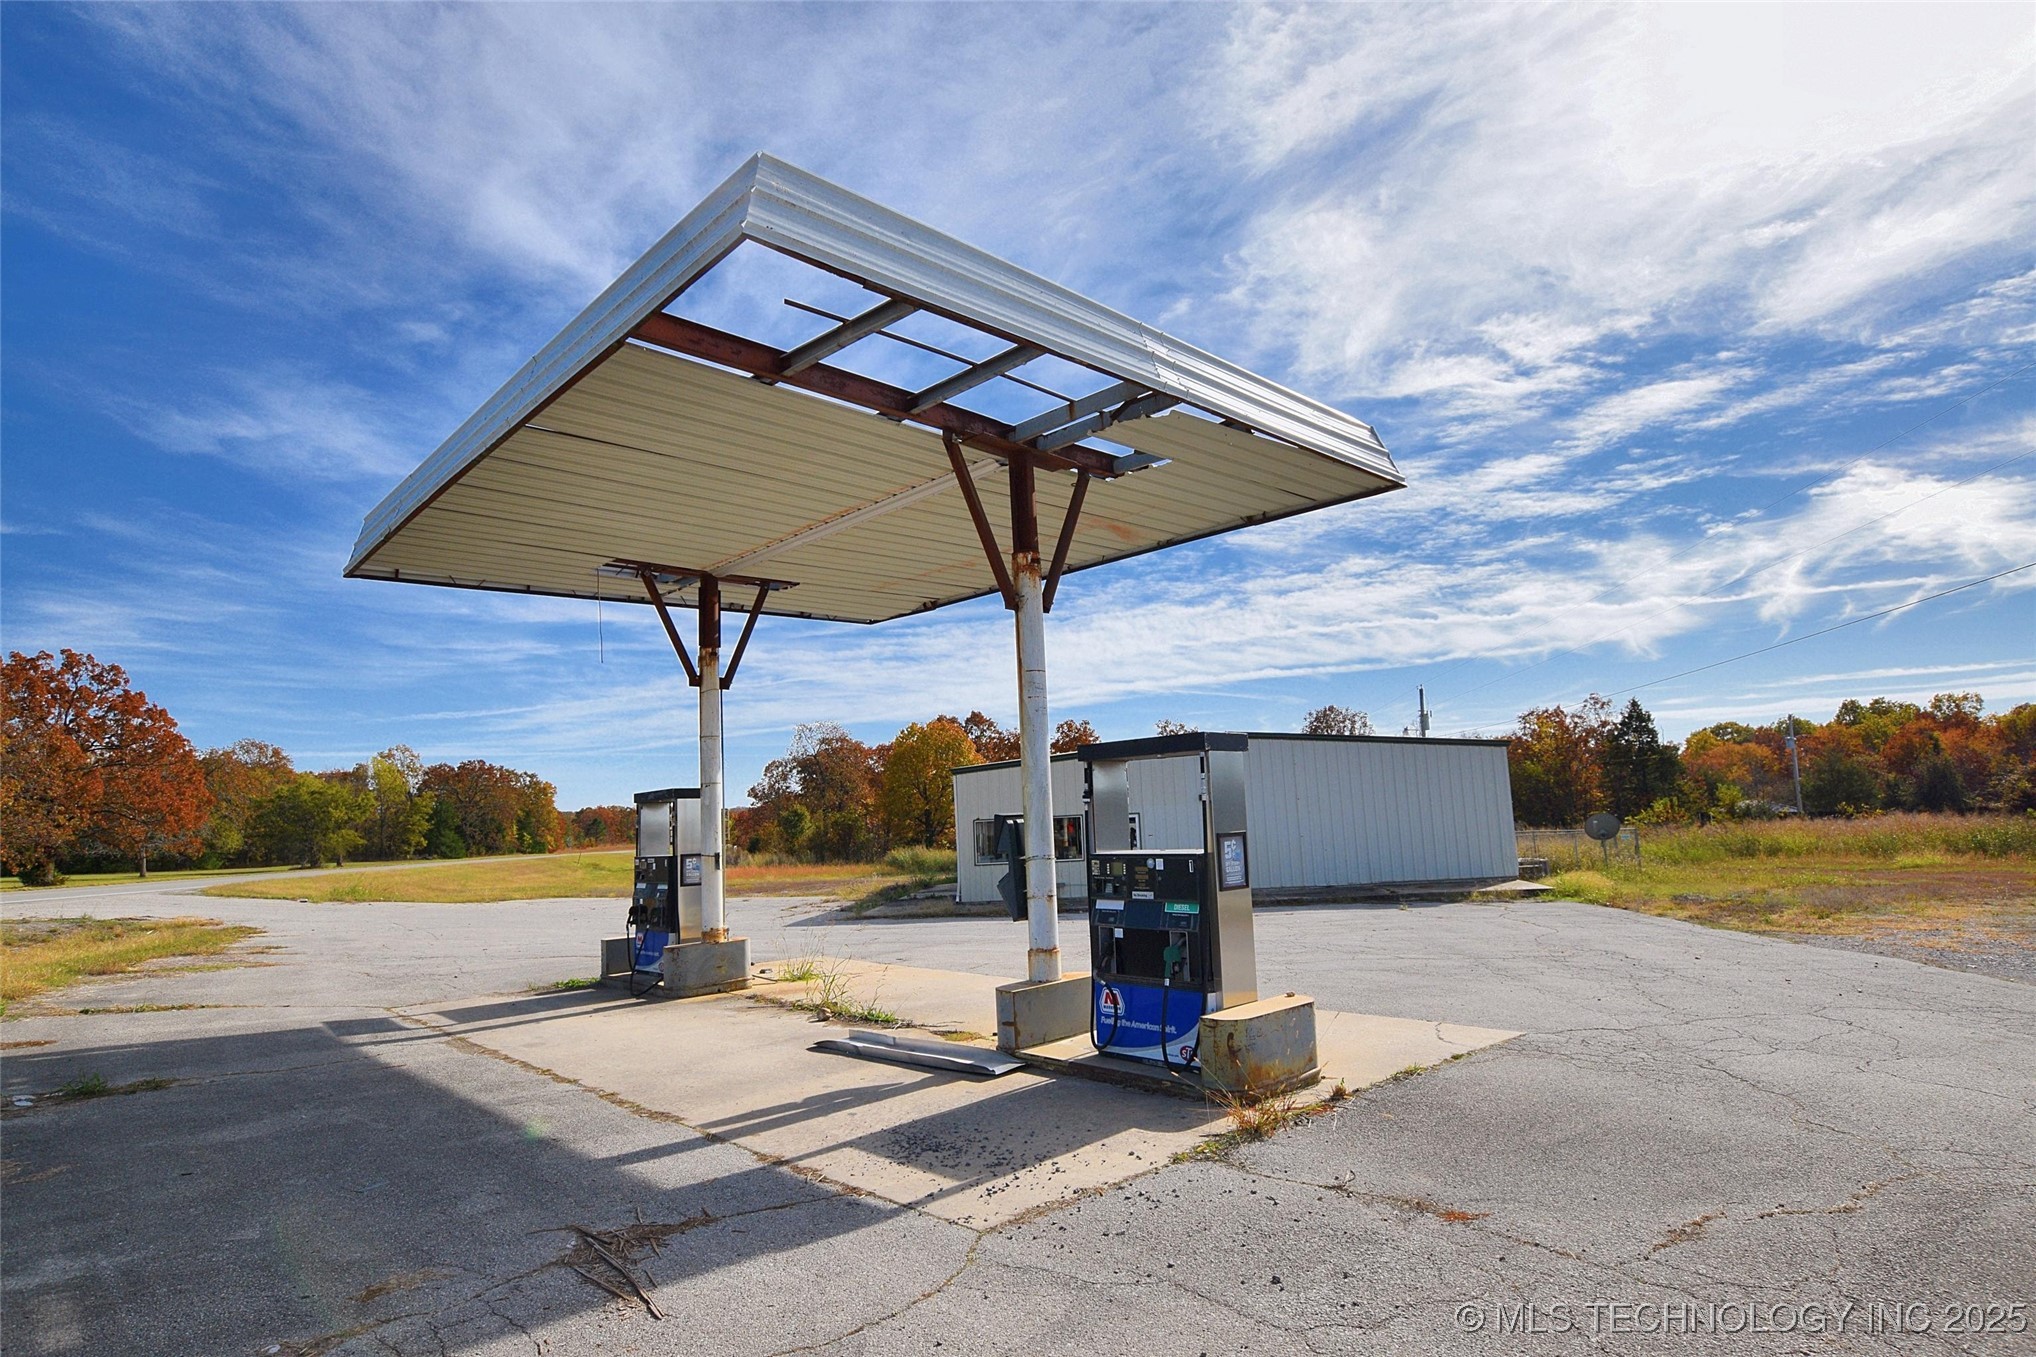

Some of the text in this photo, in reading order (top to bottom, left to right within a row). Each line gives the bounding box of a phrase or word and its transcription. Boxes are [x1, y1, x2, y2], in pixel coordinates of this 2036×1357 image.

[1173, 903, 1190, 911] DIESEL
[1121, 1018, 1131, 1028] the
[1131, 1020, 1159, 1032] American
